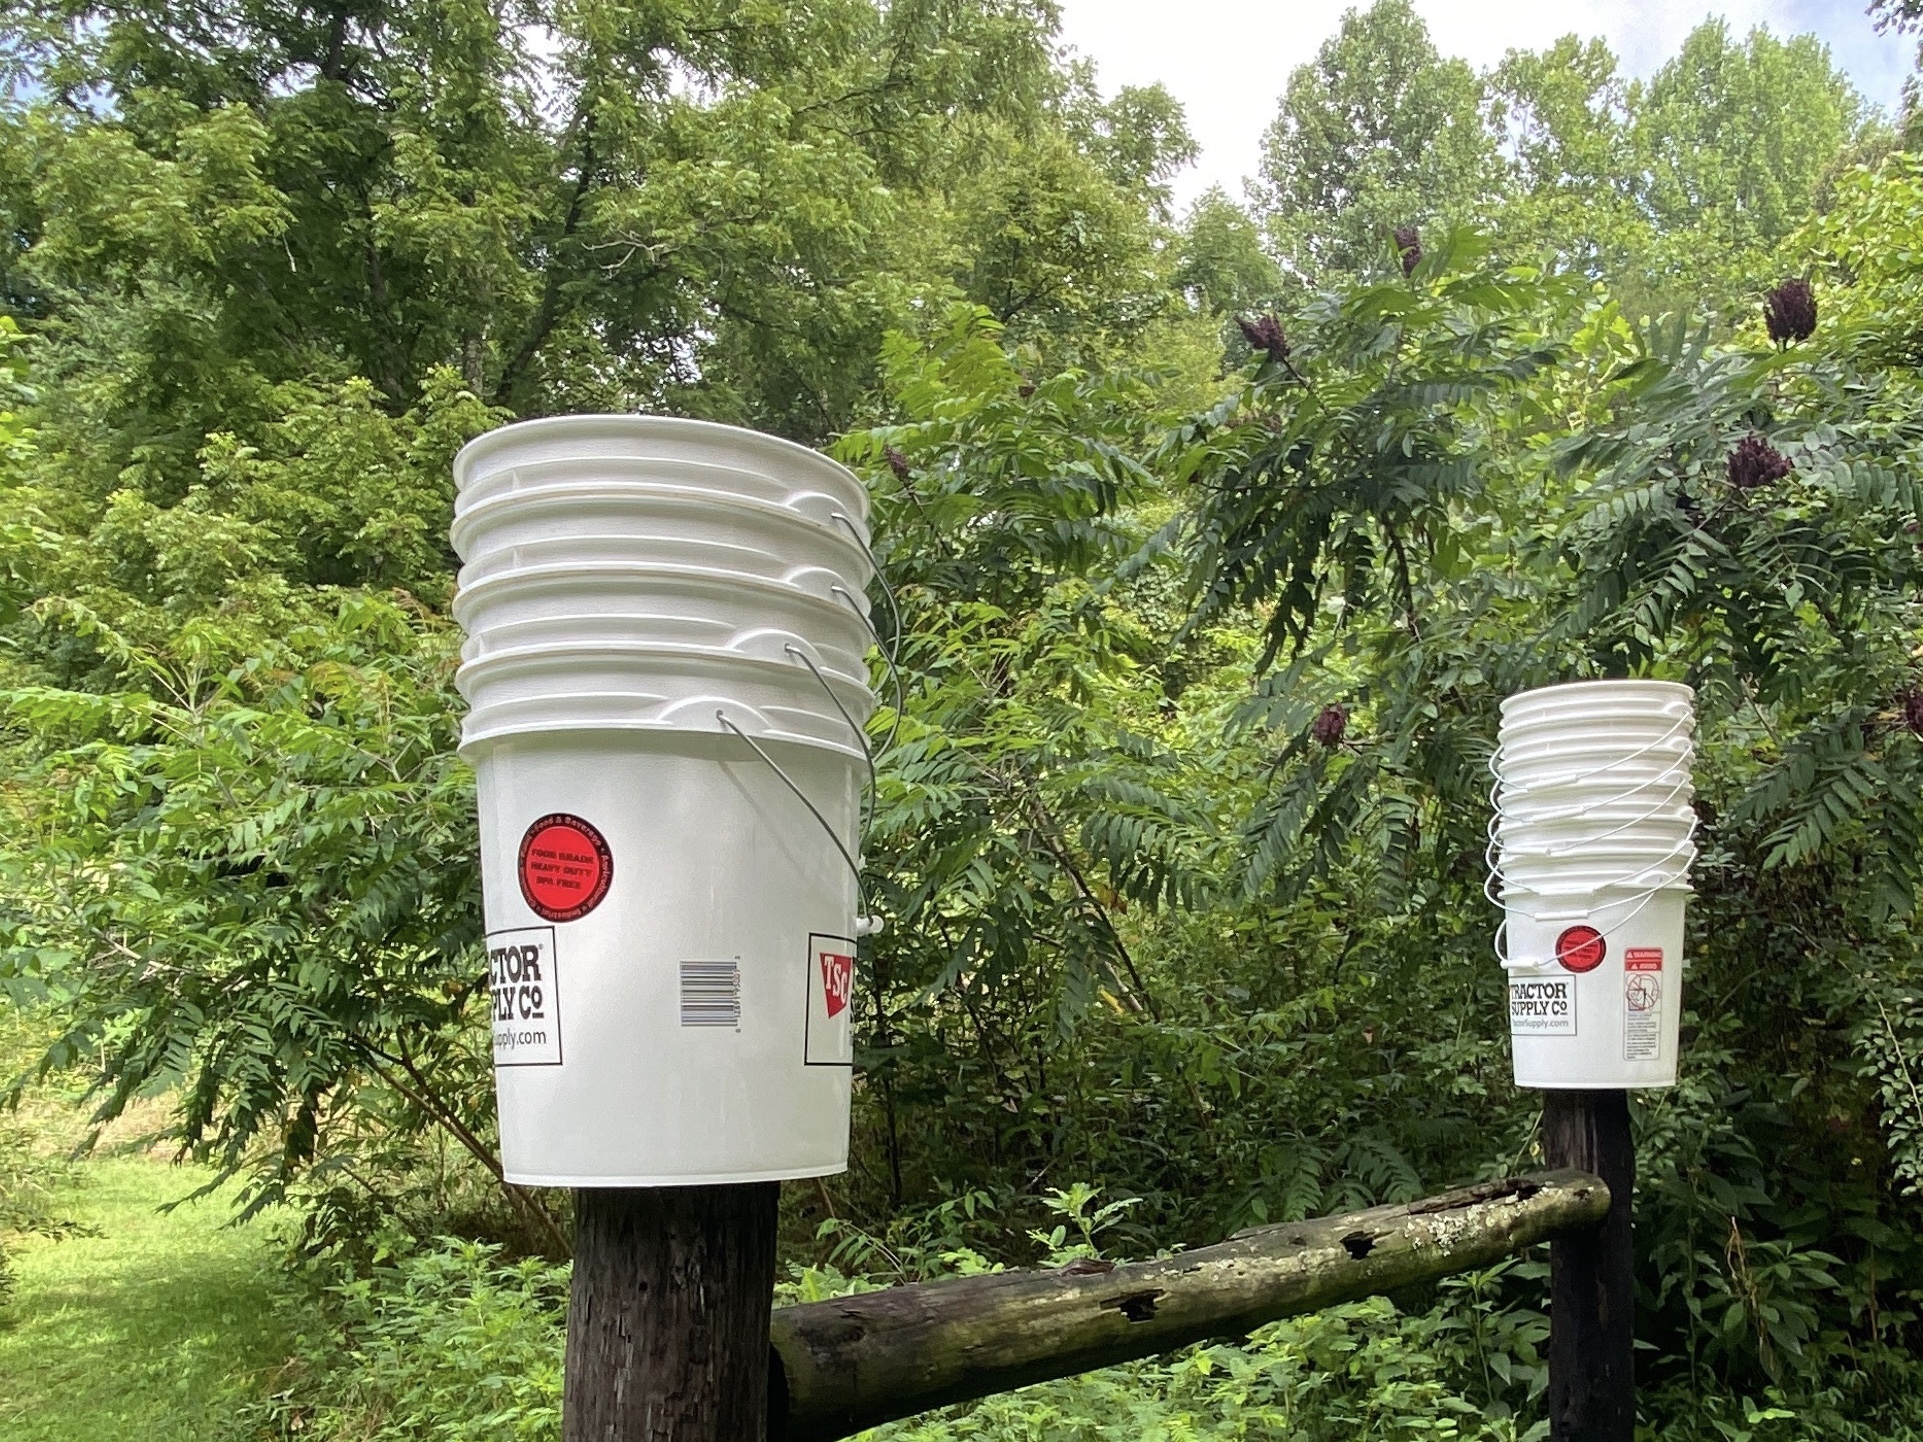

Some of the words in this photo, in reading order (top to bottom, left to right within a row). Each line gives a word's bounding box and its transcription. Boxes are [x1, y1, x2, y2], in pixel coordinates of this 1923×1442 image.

[824, 955, 848, 1005] TSC
[1511, 982, 1567, 1000] TRACTOR
[1511, 1001, 1549, 1016] SUPPLY
